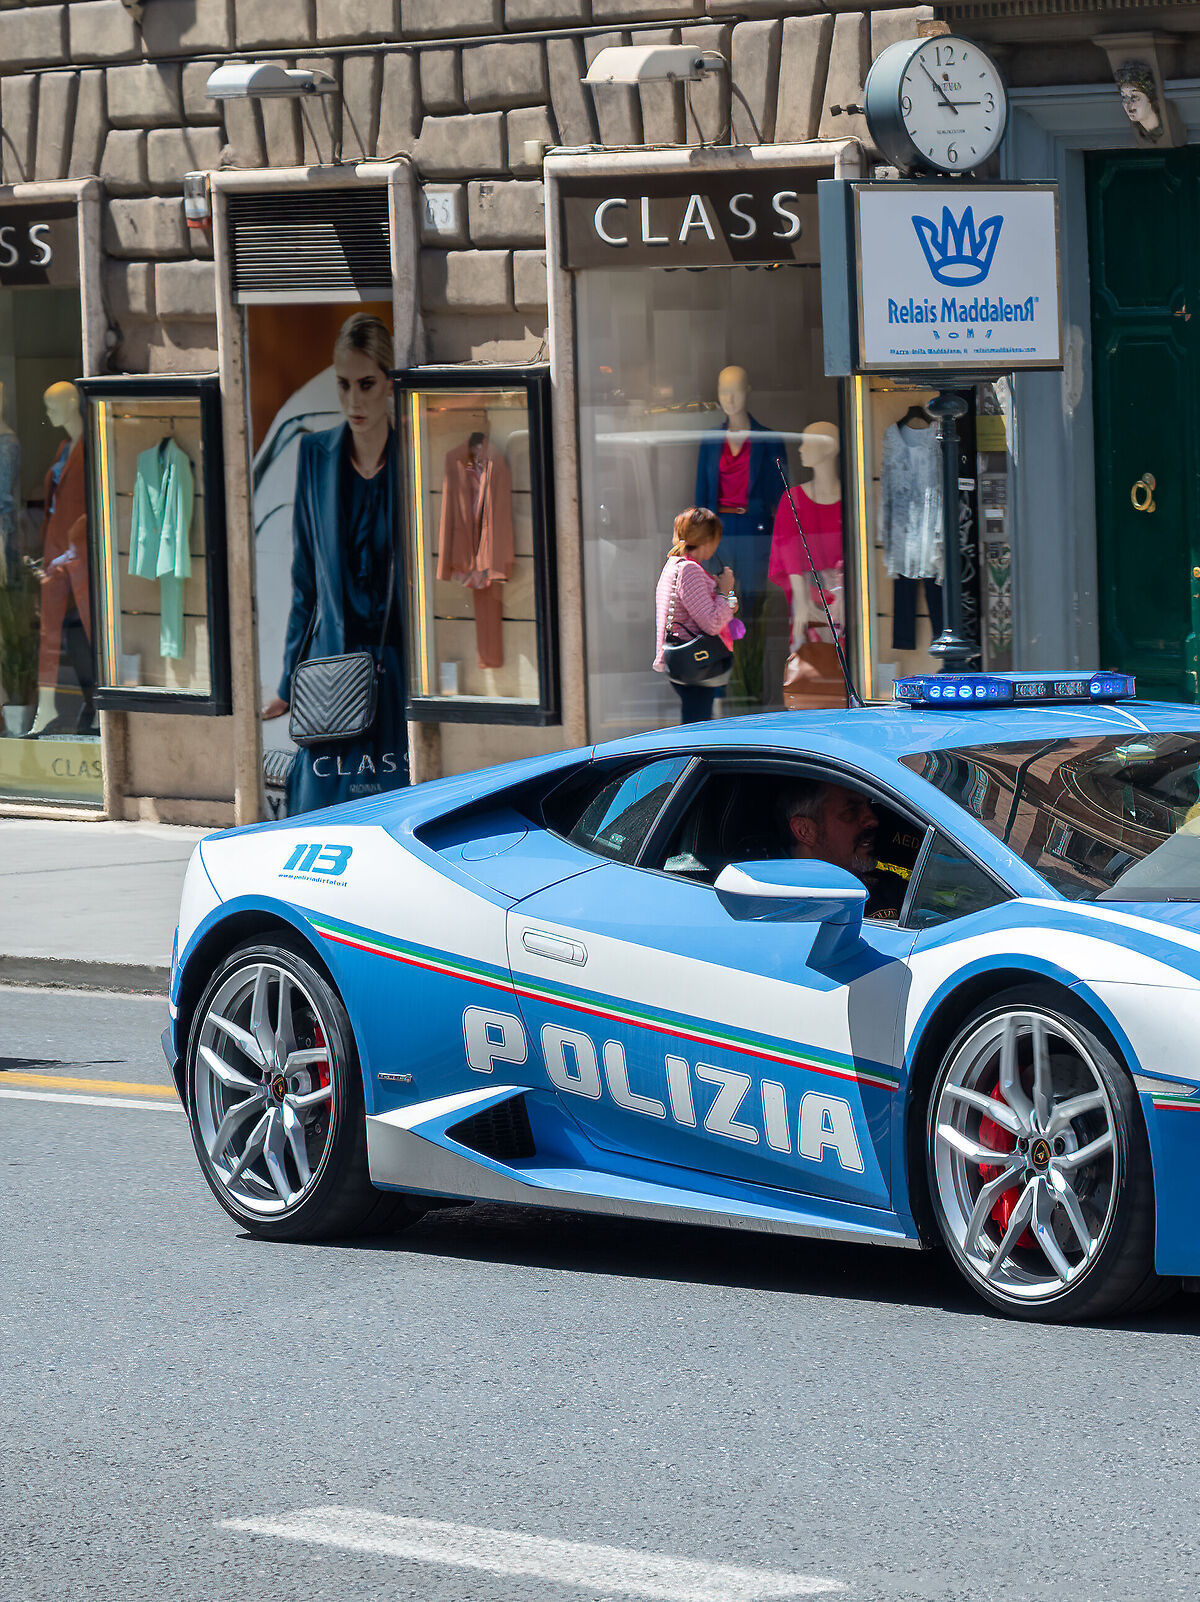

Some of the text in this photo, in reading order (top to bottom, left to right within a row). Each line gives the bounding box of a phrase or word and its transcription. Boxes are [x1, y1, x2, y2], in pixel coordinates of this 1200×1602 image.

[934, 45, 955, 67] 12
[901, 96, 912, 117] 9
[984, 92, 995, 113] 3
[947, 141, 958, 164] 6
[594, 190, 801, 247] CLASS
[887, 297, 938, 324] Relais
[283, 844, 353, 876] 113
[462, 1005, 865, 1174] POLIZIA
